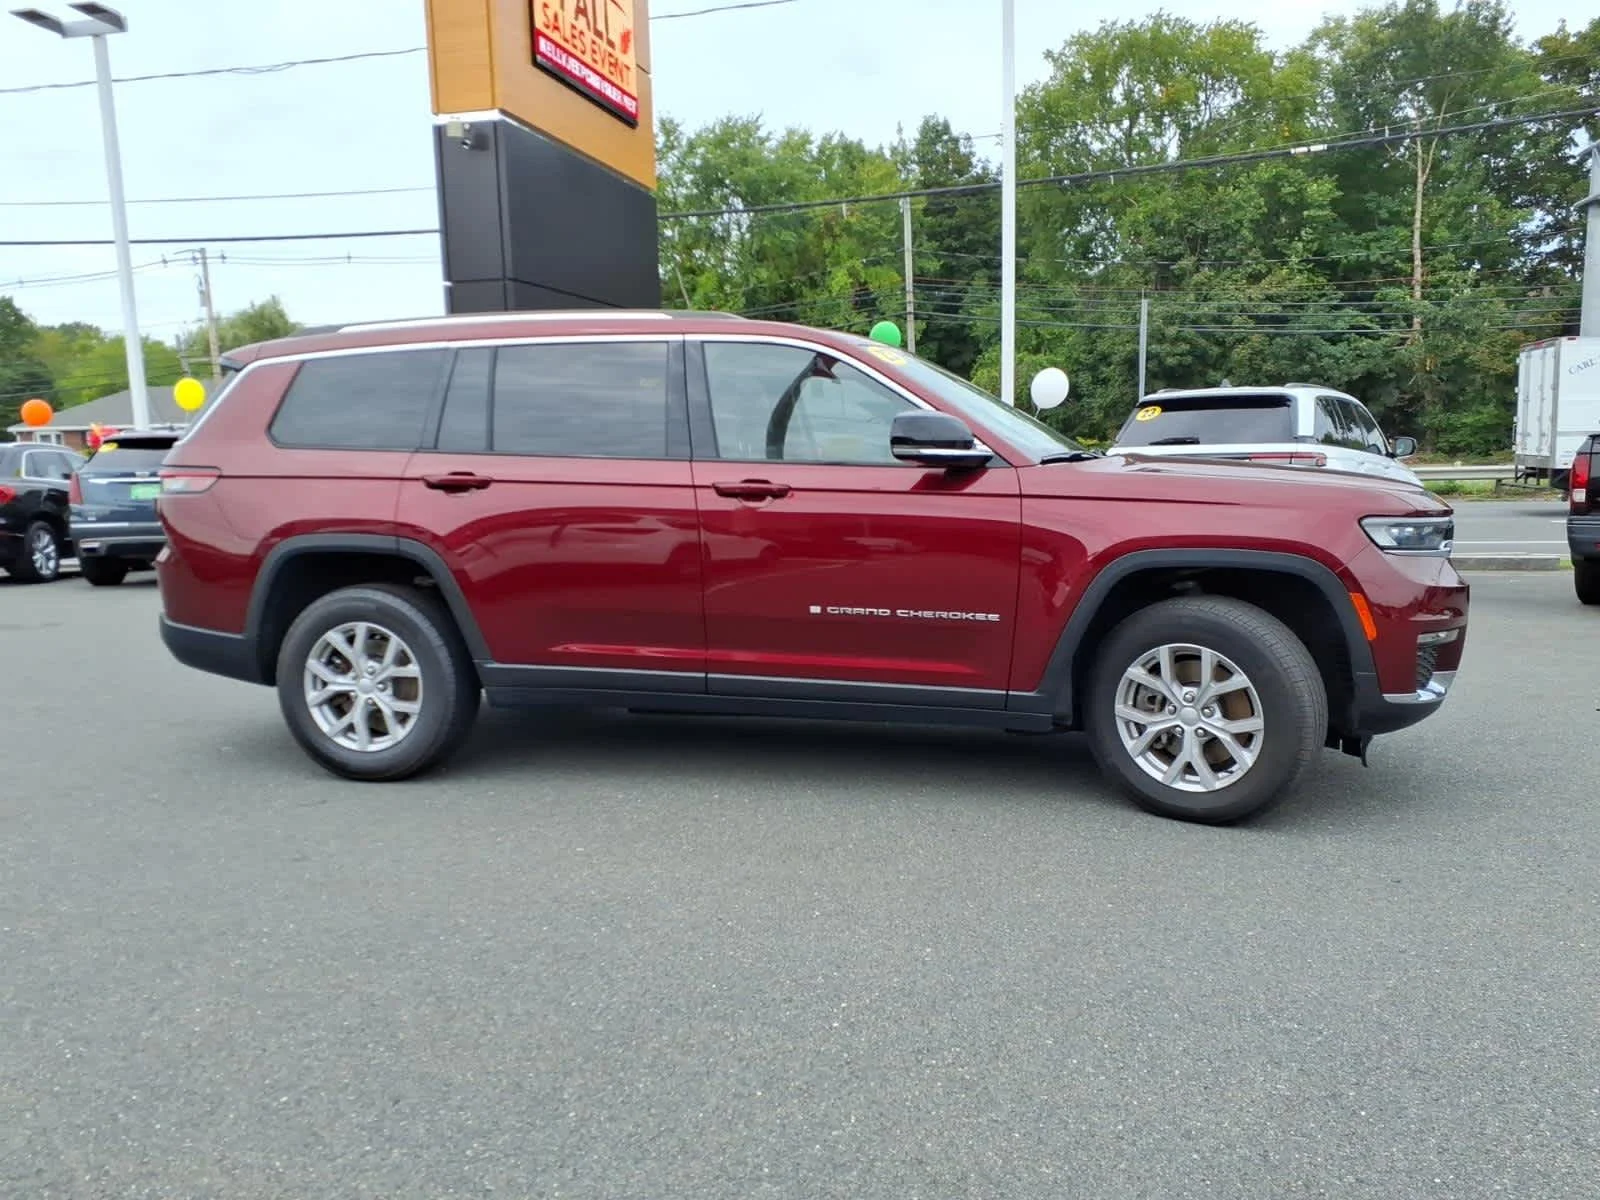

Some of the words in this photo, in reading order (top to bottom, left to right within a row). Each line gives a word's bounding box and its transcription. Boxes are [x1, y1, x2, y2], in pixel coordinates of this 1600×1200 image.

[542, 2, 587, 56] SALES
[591, 38, 631, 86] EVENT
[826, 606, 891, 616] GRAND
[896, 609, 1000, 621] CHEROKEE
